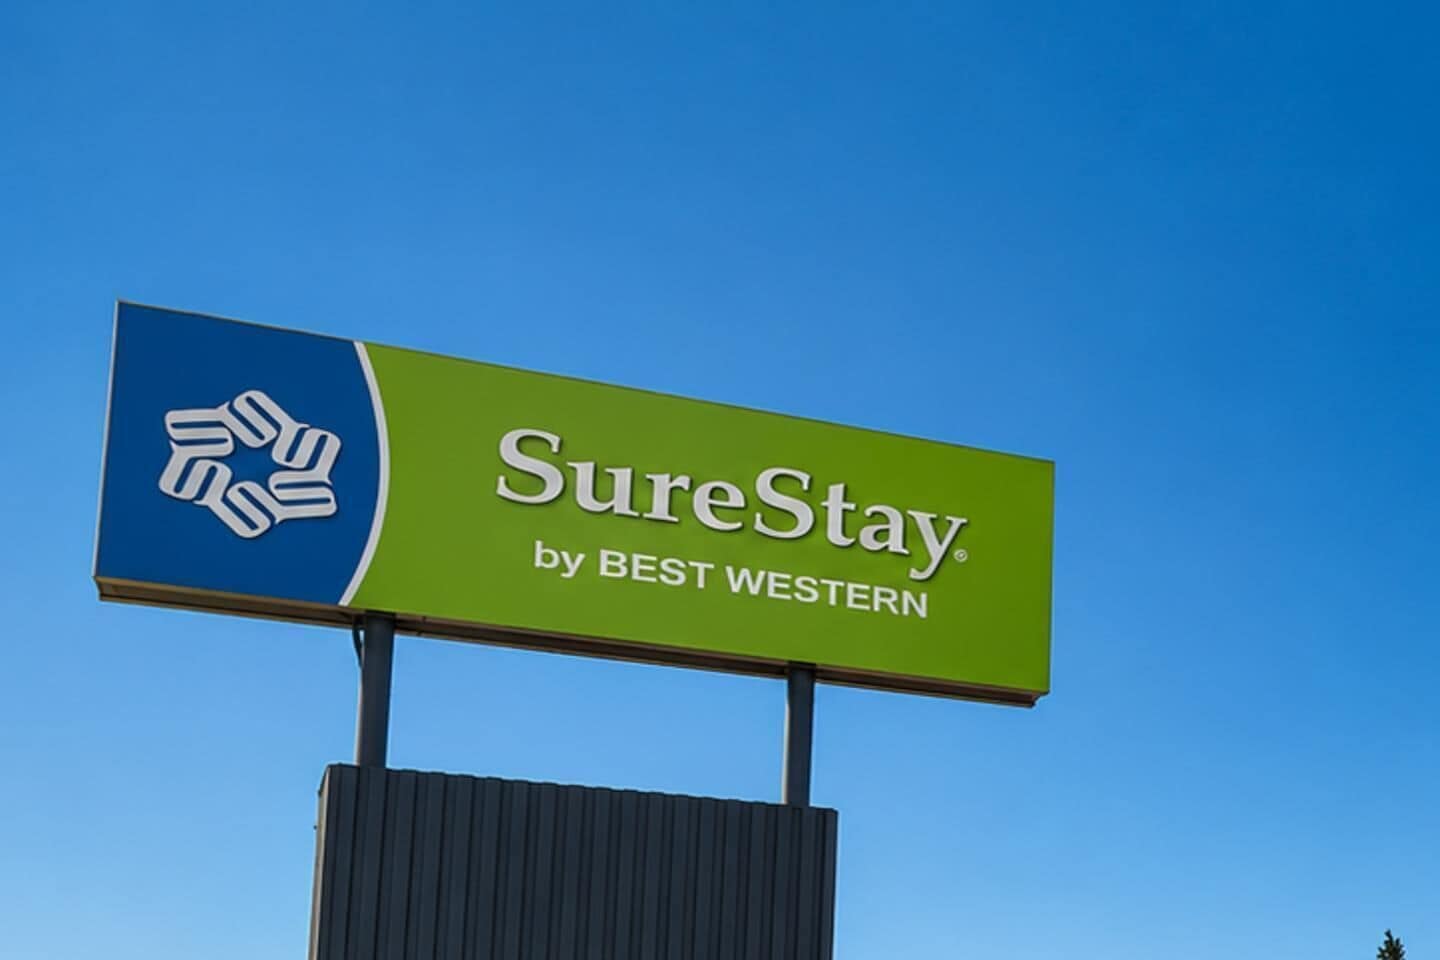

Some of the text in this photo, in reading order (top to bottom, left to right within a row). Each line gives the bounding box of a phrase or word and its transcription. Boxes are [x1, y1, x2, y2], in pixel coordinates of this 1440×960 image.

[496, 428, 967, 580] SureStay
[534, 541, 928, 618] by BEST WESTERN
